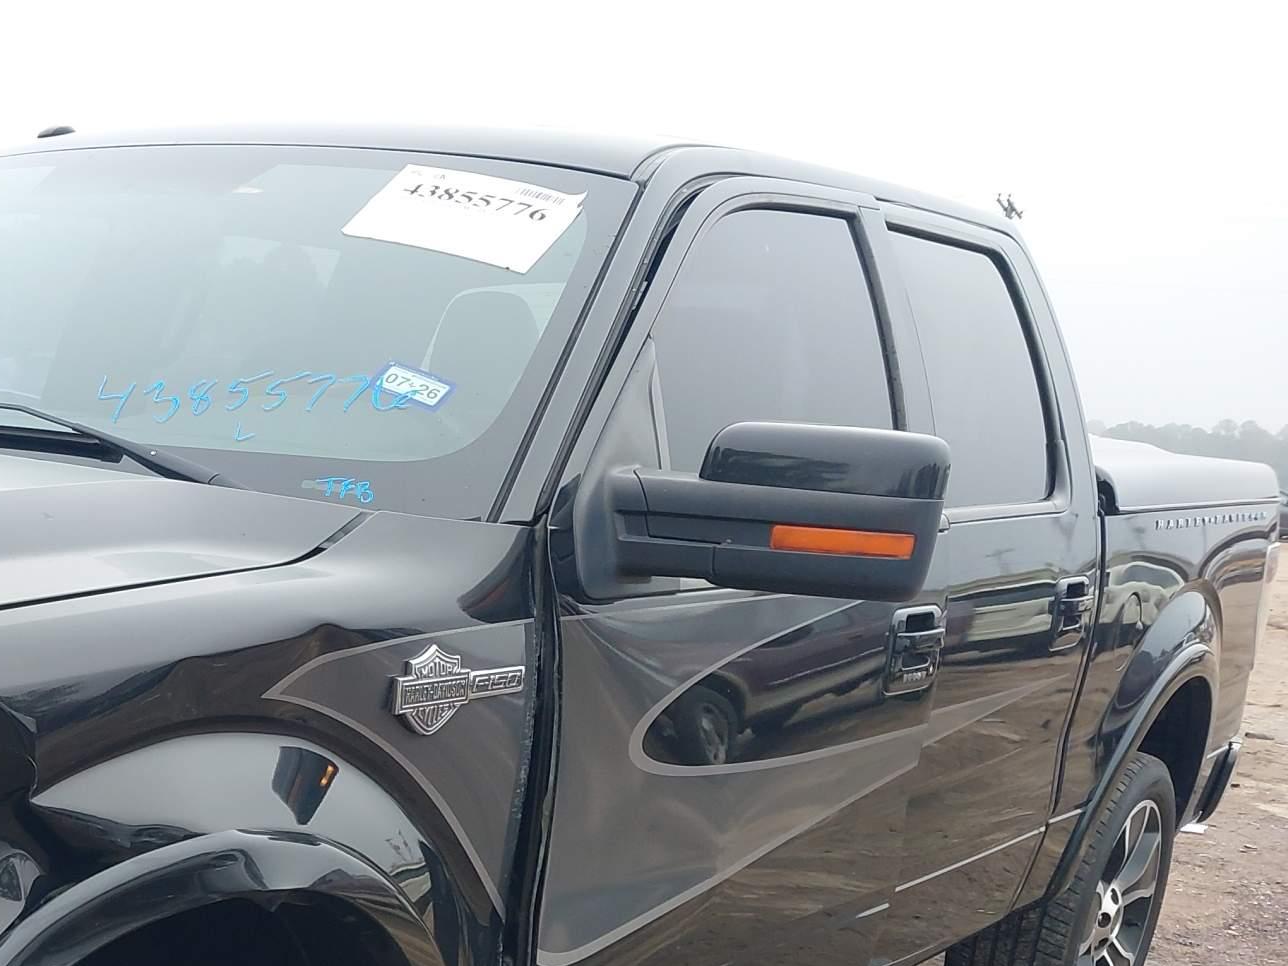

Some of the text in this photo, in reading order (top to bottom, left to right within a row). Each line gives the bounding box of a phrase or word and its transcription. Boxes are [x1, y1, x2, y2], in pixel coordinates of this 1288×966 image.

[419, 658, 456, 678] MOTOR
[404, 681, 466, 704] HARLEY-DAVIDSON
[417, 704, 451, 725] CYCLES
